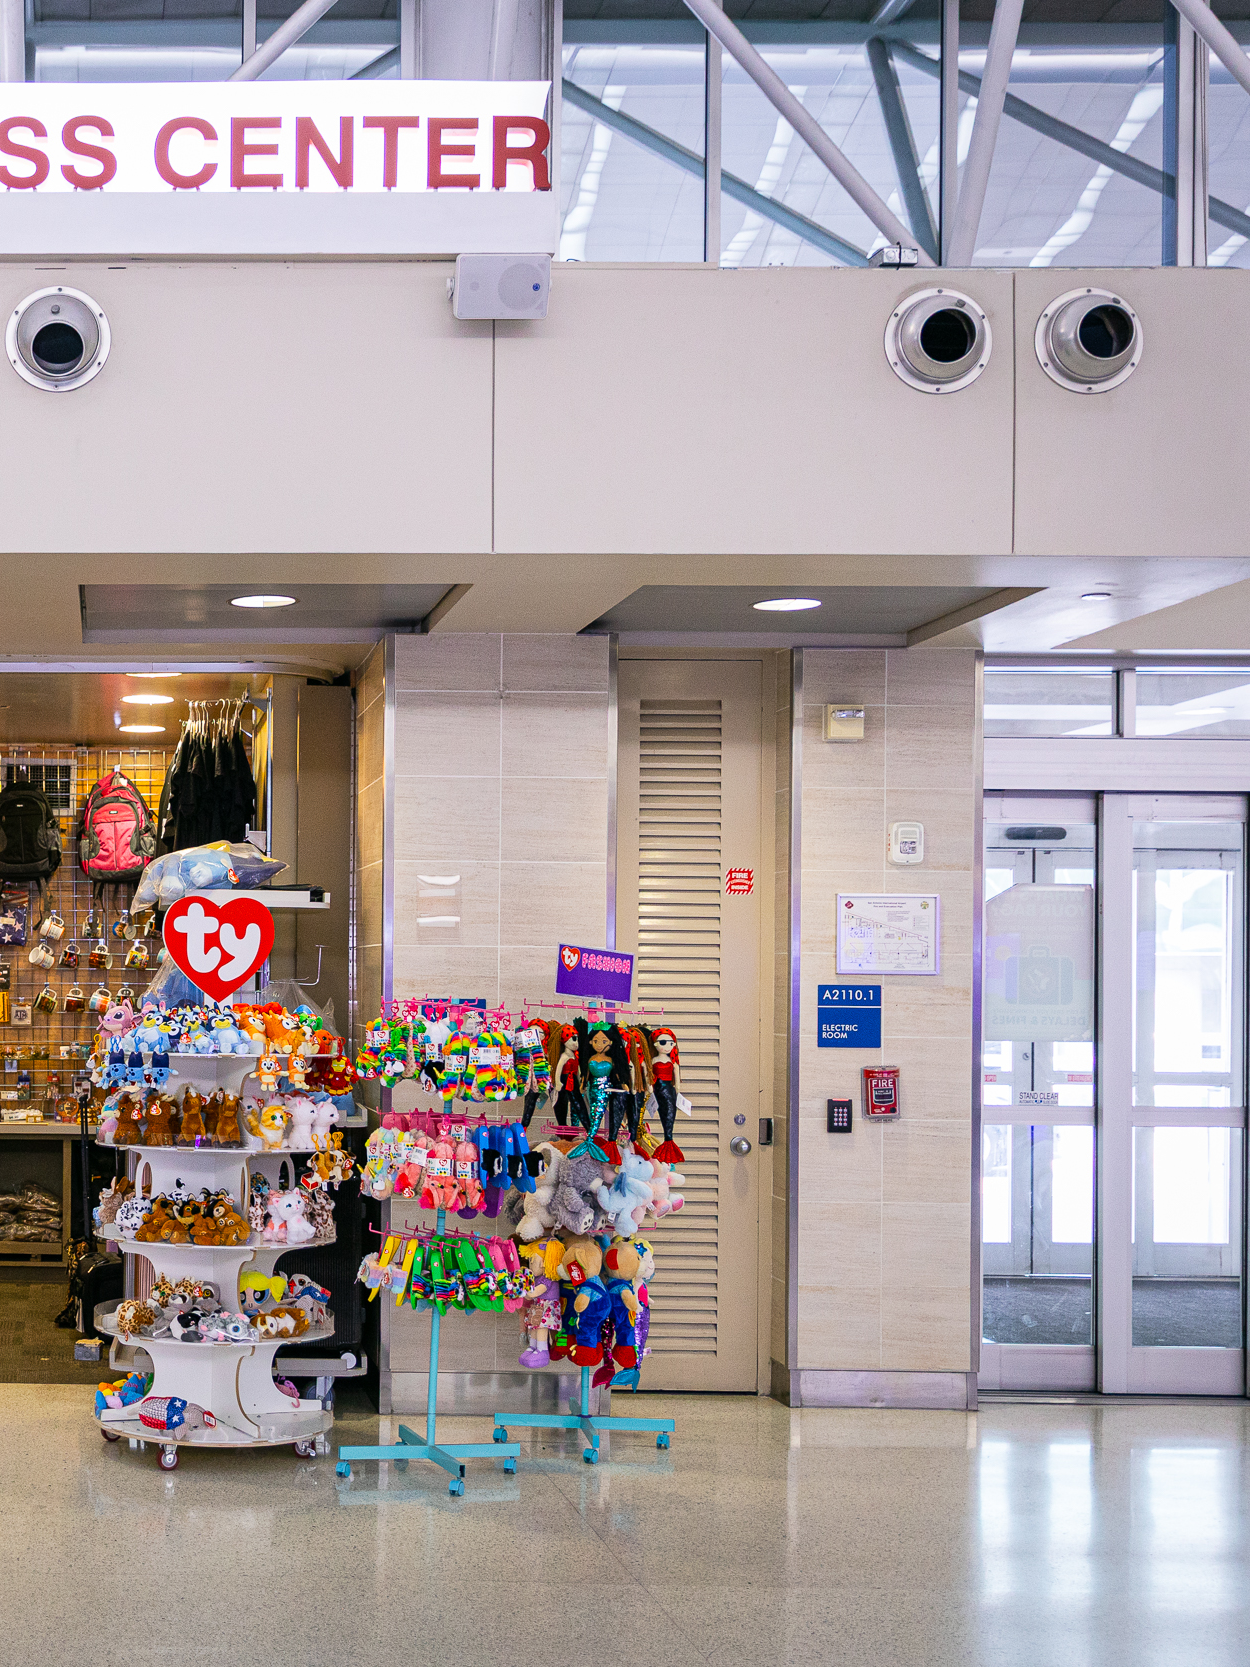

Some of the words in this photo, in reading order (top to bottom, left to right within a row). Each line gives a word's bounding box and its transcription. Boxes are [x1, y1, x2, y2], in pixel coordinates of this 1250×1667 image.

[154, 115, 551, 191] CENTER
[173, 902, 261, 982] ty
[562, 947, 579, 967] ty
[581, 952, 631, 975] FASHION
[823, 989, 873, 1000] A2110.1
[822, 1031, 848, 1039] ROOM
[872, 1079, 894, 1087] FIRE
[1019, 1092, 1039, 1100] STAND
[1039, 1092, 1059, 1100] CLEAR
